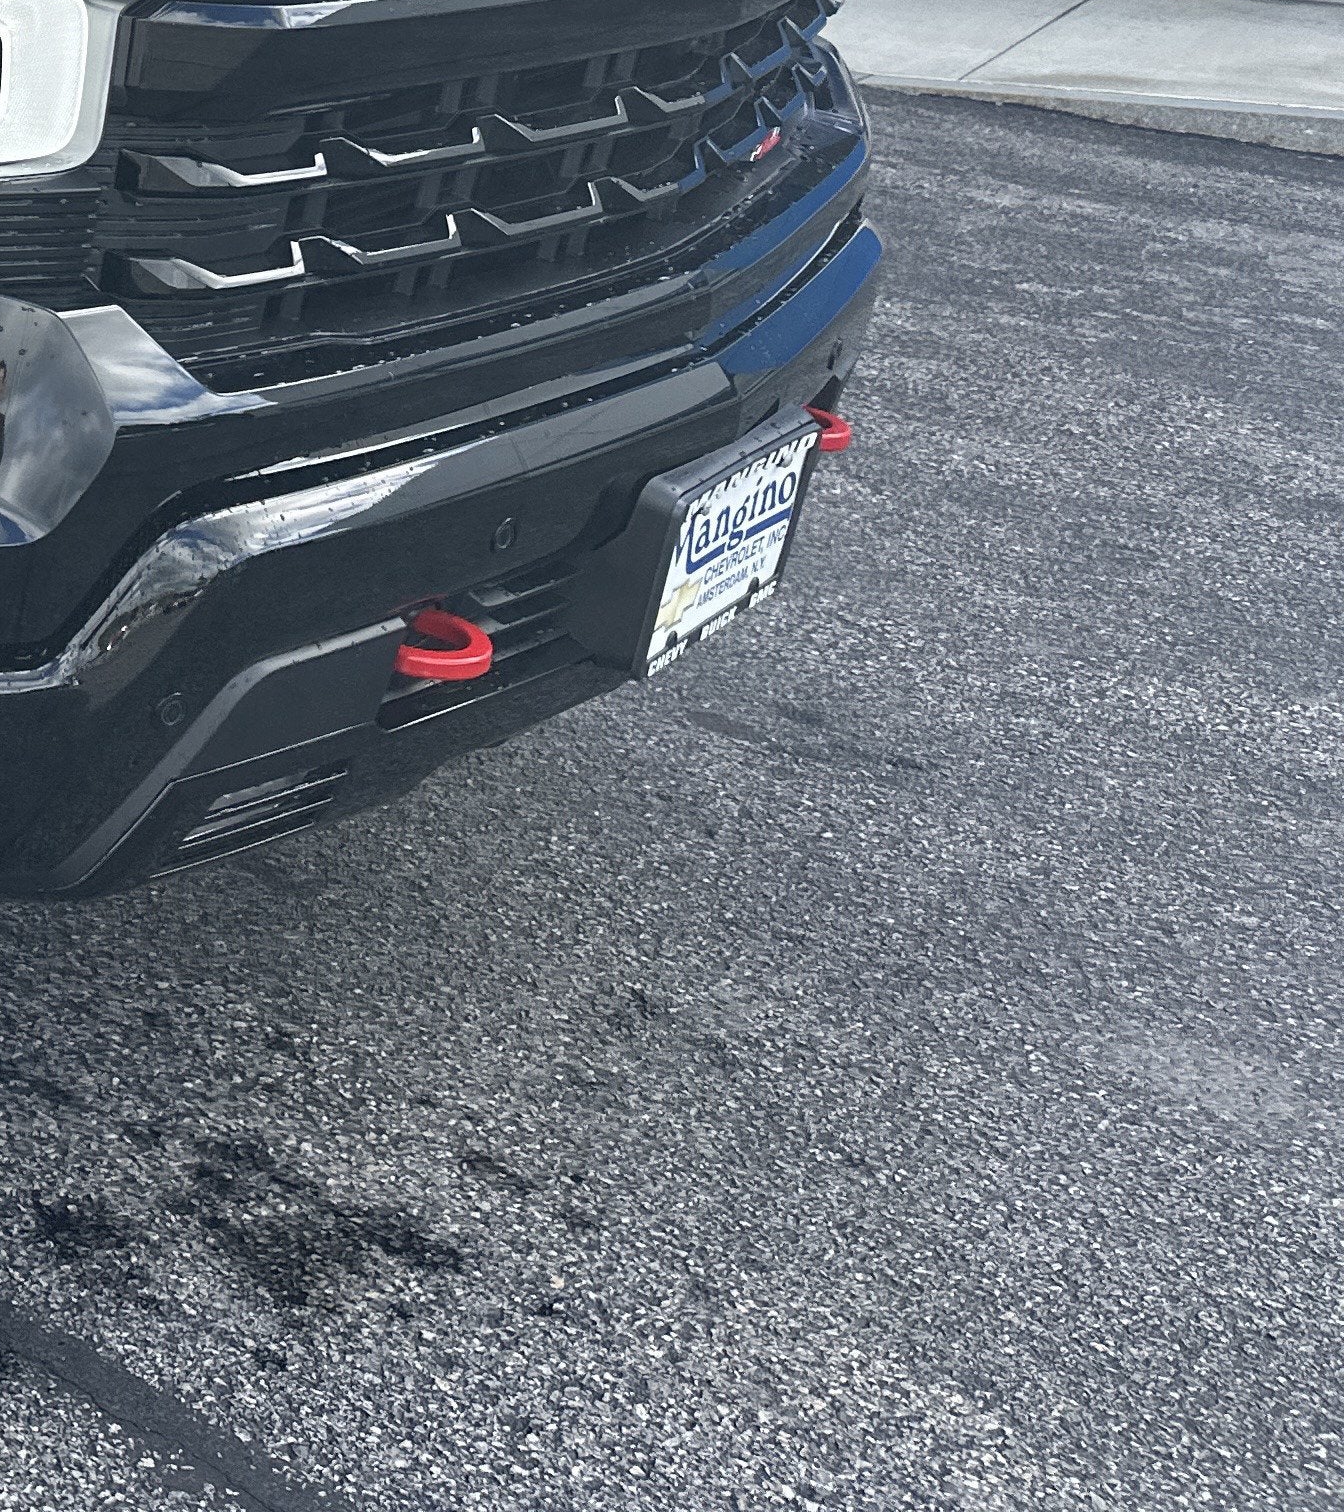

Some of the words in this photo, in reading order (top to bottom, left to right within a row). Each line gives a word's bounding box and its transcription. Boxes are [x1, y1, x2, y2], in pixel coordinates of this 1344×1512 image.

[675, 471, 797, 575] Mangino
[647, 638, 689, 677] CHEVY
[699, 605, 738, 641] BUICK
